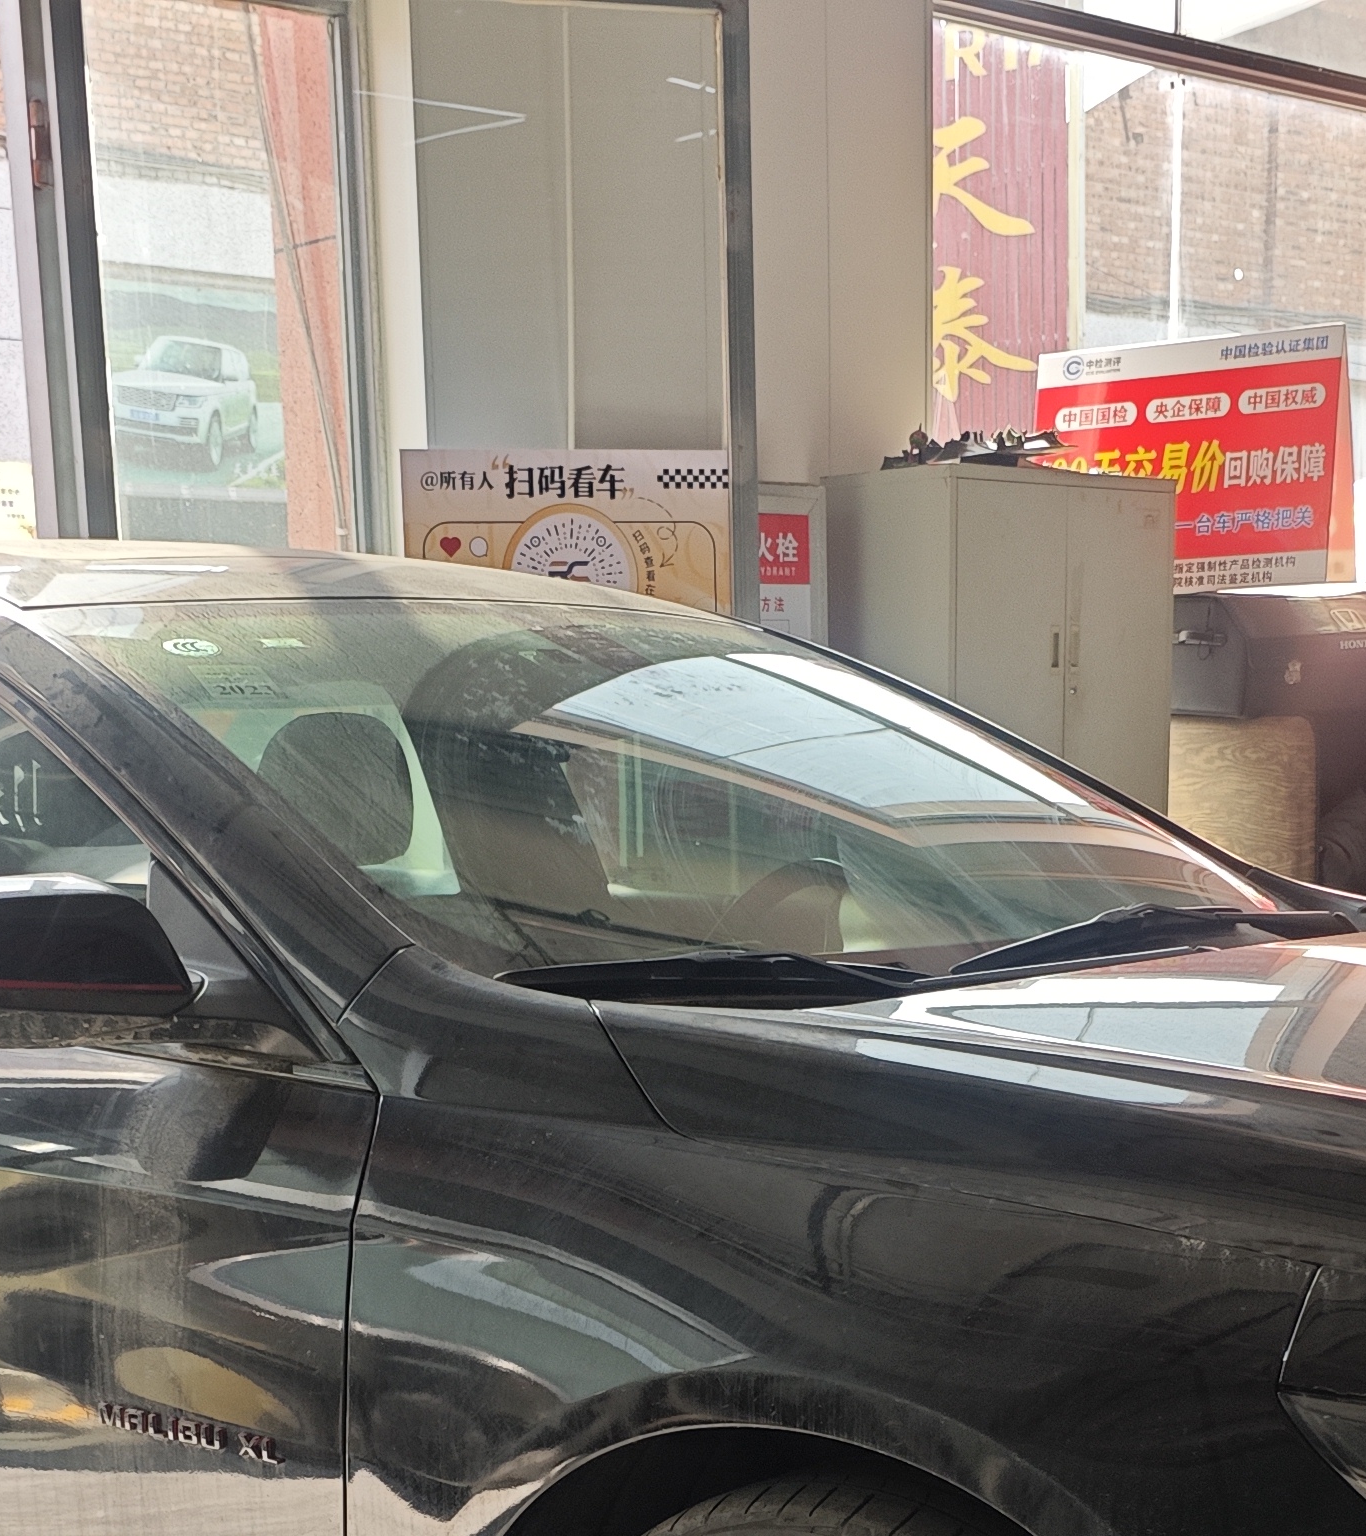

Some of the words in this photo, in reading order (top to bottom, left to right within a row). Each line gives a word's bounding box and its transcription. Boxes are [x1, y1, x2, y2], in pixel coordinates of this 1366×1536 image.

[1220, 334, 1329, 361] 中国检验认证集团
[1153, 393, 1223, 421] 央企保障
[1247, 386, 1318, 411] 中国权威
[1062, 404, 1130, 429] 中国国检
[420, 470, 495, 493] @所有人
[1175, 505, 1313, 537] 一台车严格把关
[758, 532, 799, 564] 火栓
[1174, 555, 1297, 574] 指定强制性产品检测机构
[761, 597, 785, 613] 方法
[97, 1401, 228, 1451] MALIBU
[238, 1431, 286, 1465] XL
